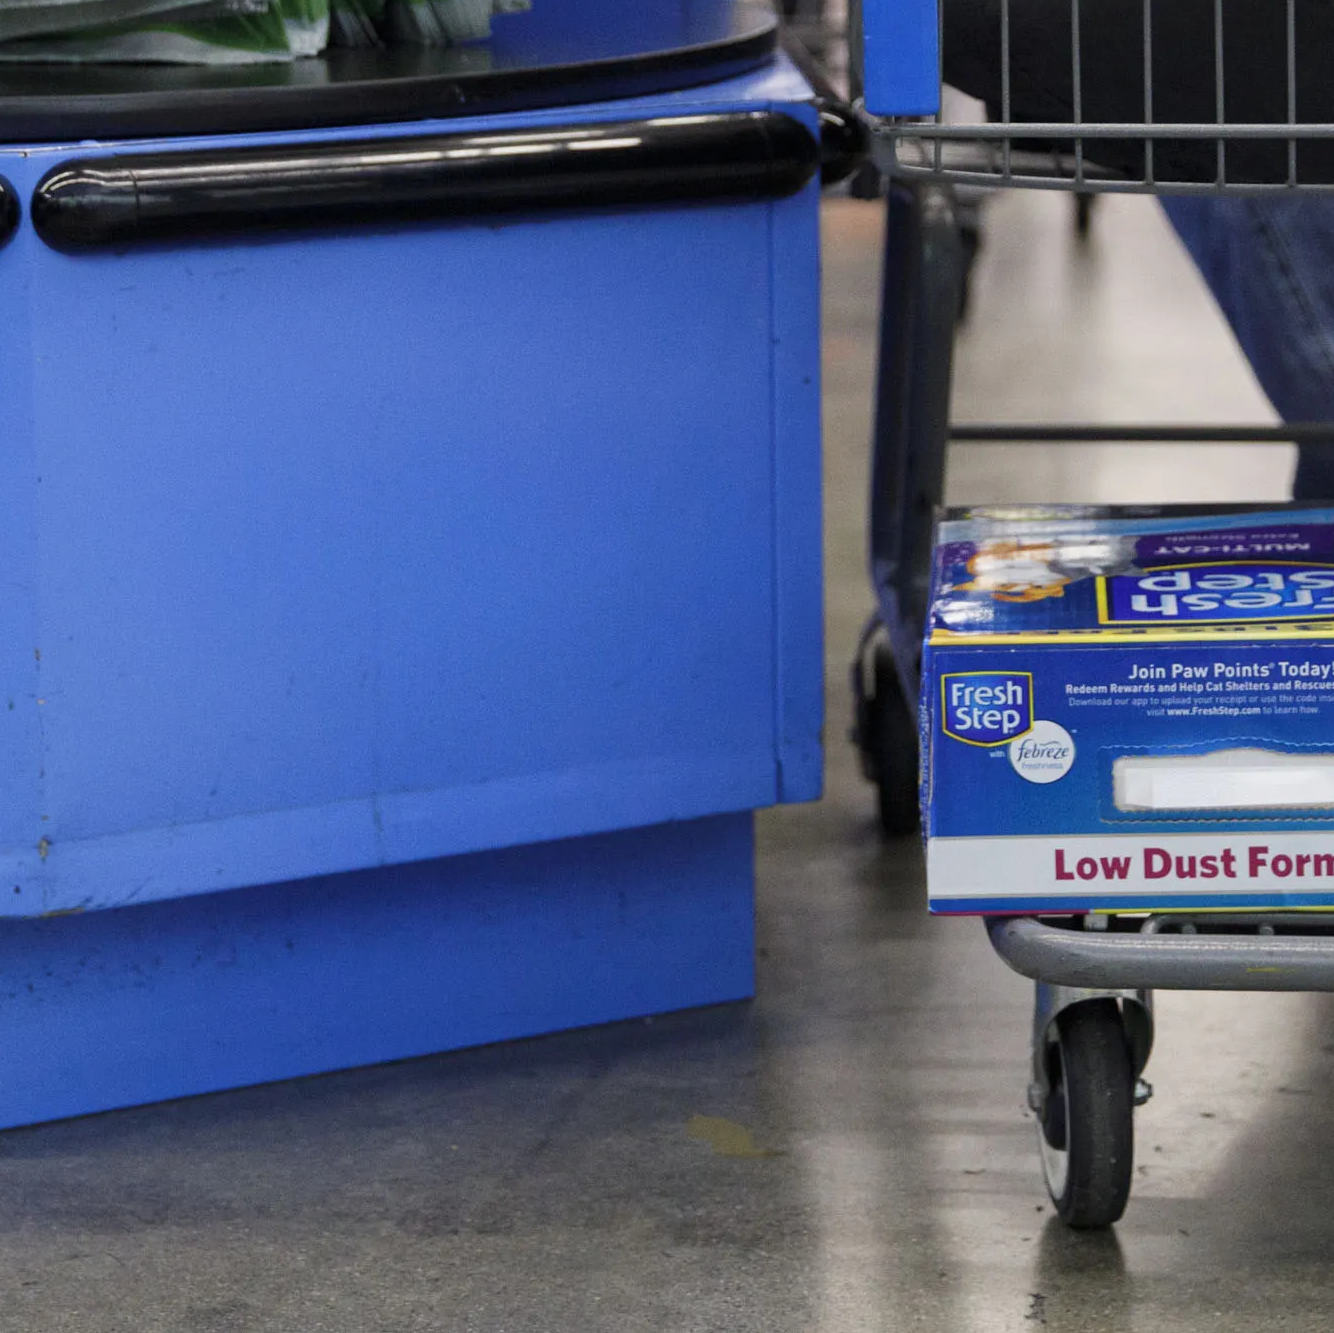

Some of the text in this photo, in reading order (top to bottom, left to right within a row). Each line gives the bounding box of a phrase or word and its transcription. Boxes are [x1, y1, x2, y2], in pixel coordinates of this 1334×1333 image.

[1155, 542, 1311, 554] MULTI-CAT
[1128, 664, 1166, 680] Join
[1171, 663, 1209, 679] Paw
[1214, 662, 1271, 678] Points
[952, 681, 1023, 706] Fresh
[1065, 683, 1108, 695] Redeem
[1110, 683, 1155, 694] Rewards
[1157, 682, 1177, 693] and
[1179, 682, 1204, 694] Help
[1205, 681, 1223, 692] Cat
[1225, 680, 1271, 692] Shelters
[1272, 680, 1292, 691] and
[1068, 697, 1113, 707] Download
[1114, 698, 1130, 706] our
[1131, 697, 1148, 707] app
[1150, 696, 1160, 705] to
[1161, 696, 1192, 707] upload
[1193, 696, 1215, 707] your
[1216, 695, 1247, 706] receipt
[1249, 696, 1259, 704] or
[1261, 695, 1277, 703] use
[1279, 694, 1294, 703] the
[1296, 694, 1317, 702] code
[955, 707, 1021, 734] Step
[1147, 708, 1165, 716] visit
[1167, 706, 1261, 717] www.FreshStep.com
[1263, 706, 1273, 714] to
[1274, 706, 1298, 714] learn
[1017, 738, 1070, 762] febreze
[1055, 850, 1132, 881] Low
[1143, 847, 1237, 879] Dust
